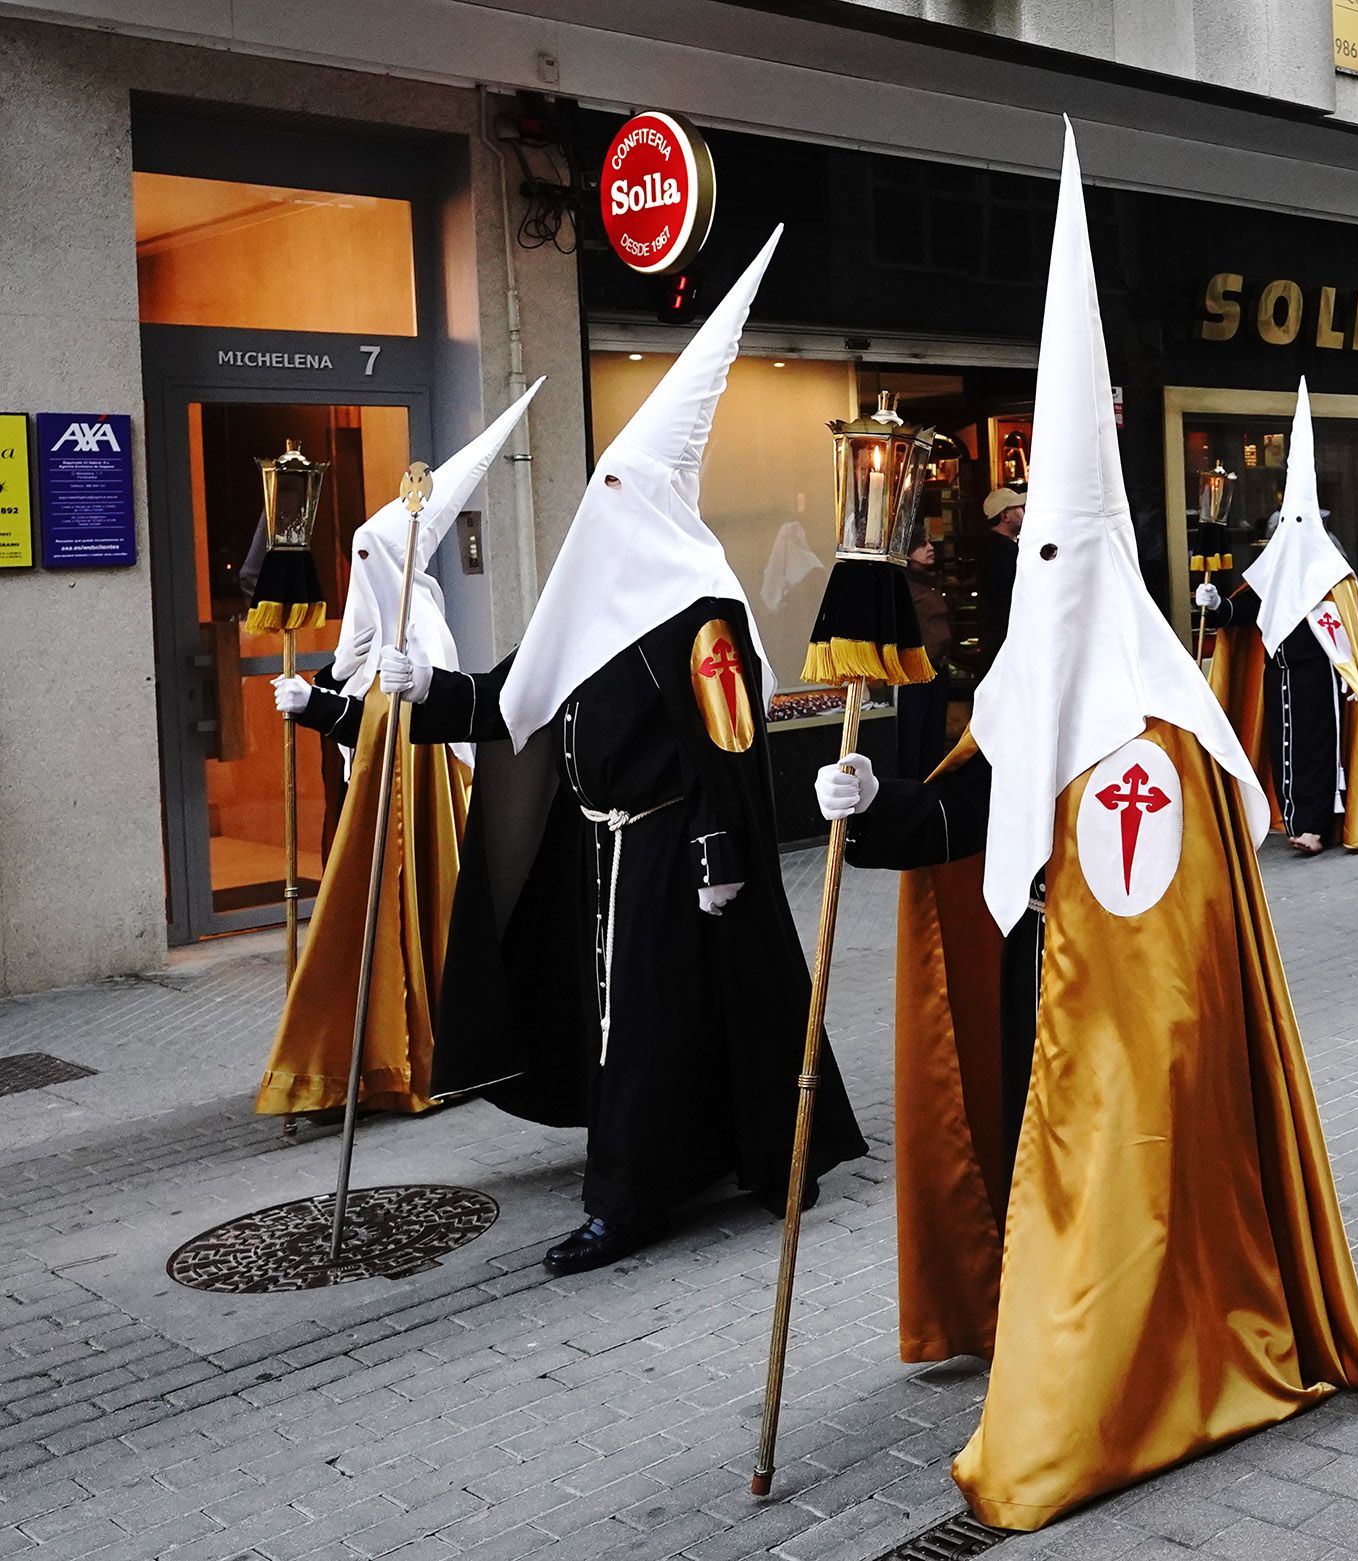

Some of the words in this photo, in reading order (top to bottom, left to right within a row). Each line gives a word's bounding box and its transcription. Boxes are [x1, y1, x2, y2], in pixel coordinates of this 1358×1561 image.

[1335, 38, 1358, 59] 986
[611, 128, 672, 170] CONFITERIA
[611, 172, 681, 216] Solla
[620, 233, 650, 256] DESDE
[651, 226, 671, 252] 1967
[218, 351, 333, 369] MICHELENA
[360, 345, 381, 376] 7
[50, 423, 121, 452] AXA
